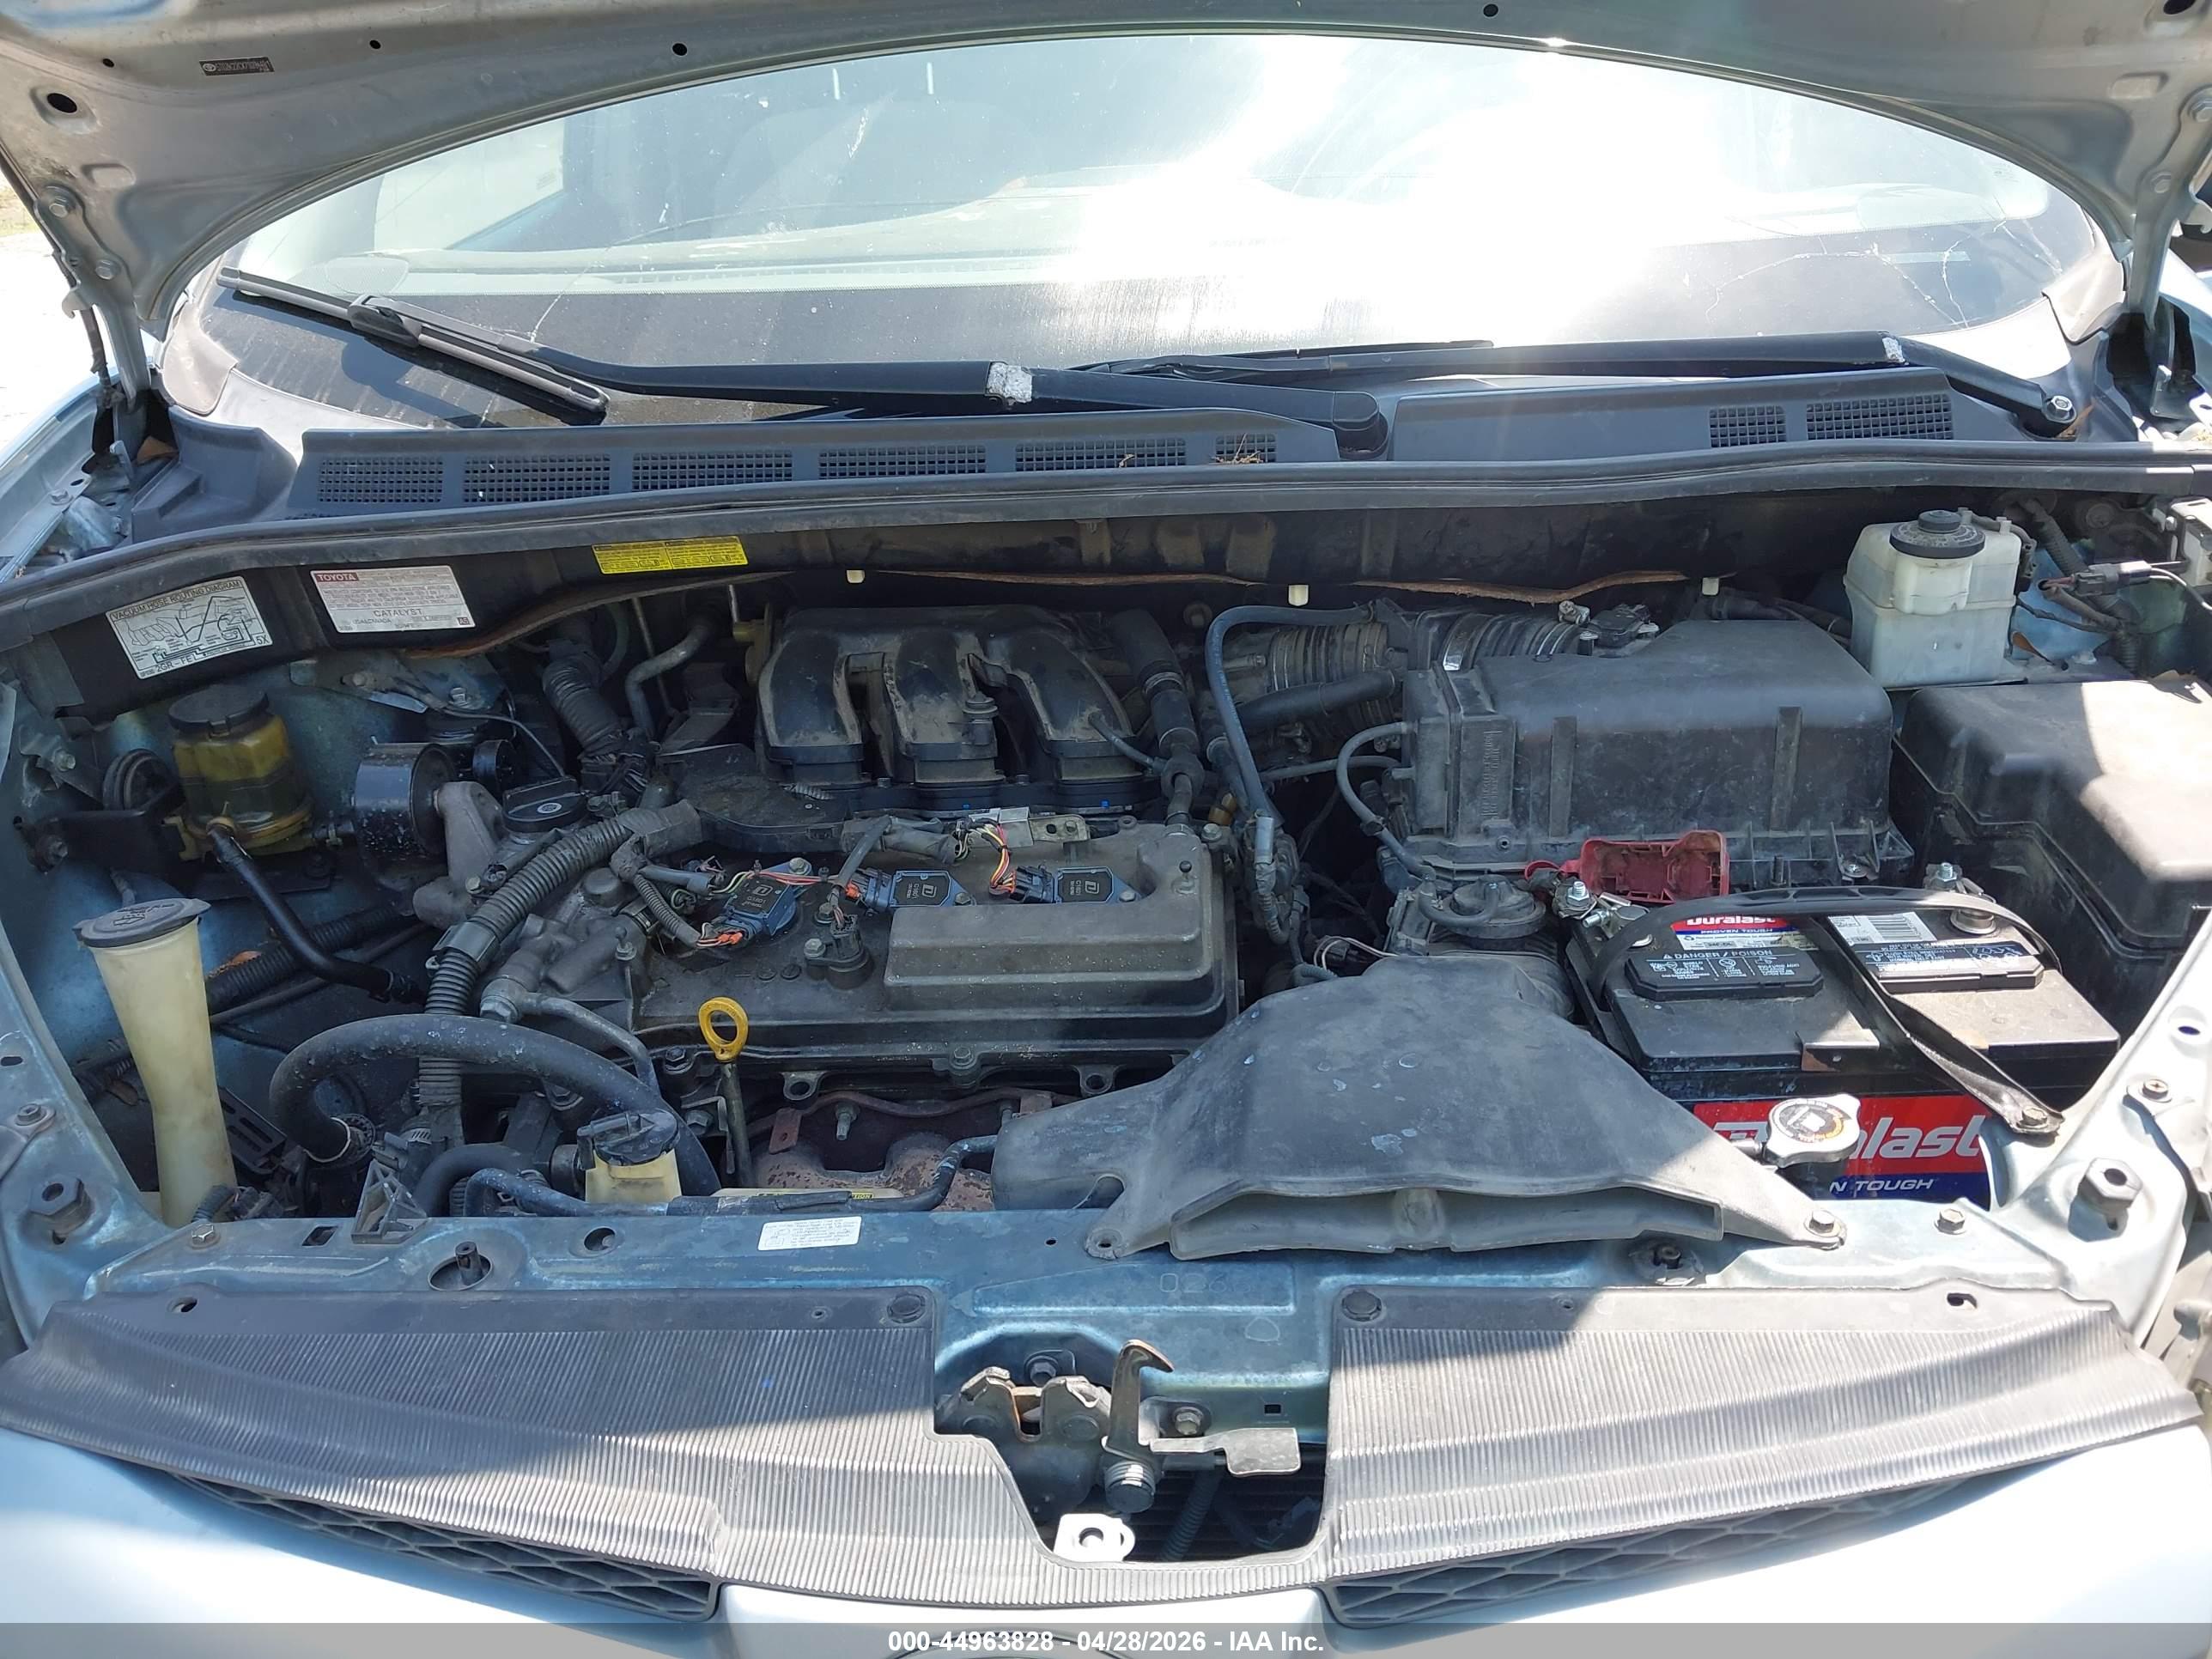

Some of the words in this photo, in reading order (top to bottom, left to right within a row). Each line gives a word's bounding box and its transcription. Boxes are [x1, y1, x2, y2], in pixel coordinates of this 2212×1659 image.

[112, 605, 146, 619] VACUUM
[147, 599, 171, 611] HOSE
[171, 589, 204, 603] ROUTING
[205, 580, 240, 595] DIAGRAM
[257, 635, 271, 644] 5X
[1674, 951, 1720, 959] DANGER
[1856, 1179, 1935, 1191] TOUGH
